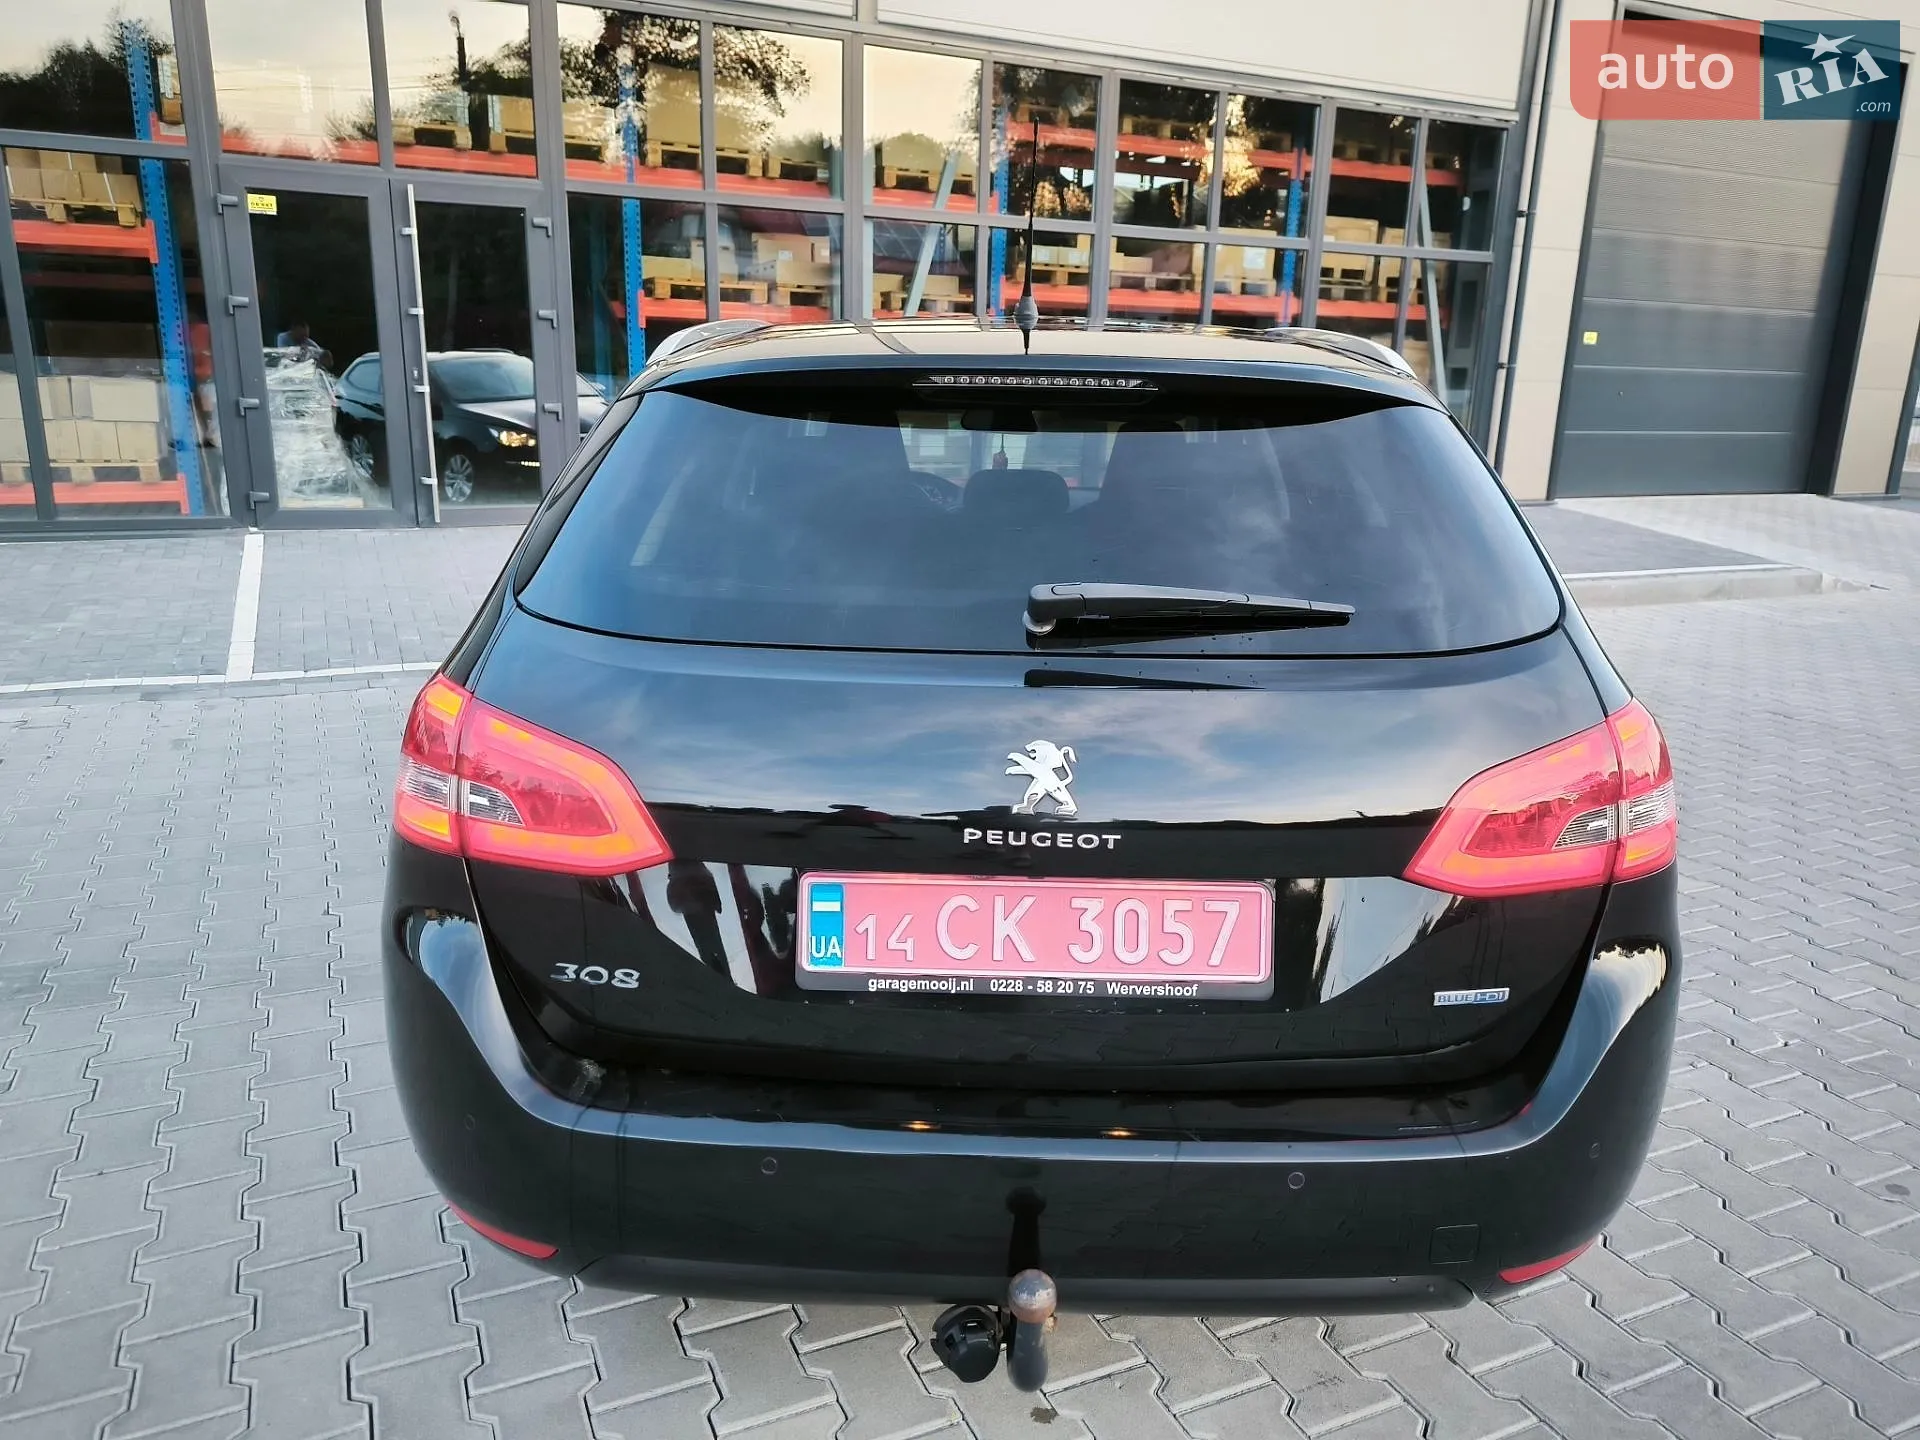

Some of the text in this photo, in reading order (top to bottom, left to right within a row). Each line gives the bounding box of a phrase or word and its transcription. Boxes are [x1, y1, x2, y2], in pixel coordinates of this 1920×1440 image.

[963, 827, 1122, 850] PEUGEOT
[854, 893, 1240, 968] 14 CK 3057
[810, 935, 843, 959] UA
[550, 962, 641, 989] 308
[868, 977, 974, 994] garagemooij.nl
[990, 978, 1024, 993] 0228
[1036, 980, 1054, 994] 58
[1056, 980, 1074, 994] 20
[1077, 981, 1095, 994] 75
[1106, 981, 1199, 997] Wervershoof
